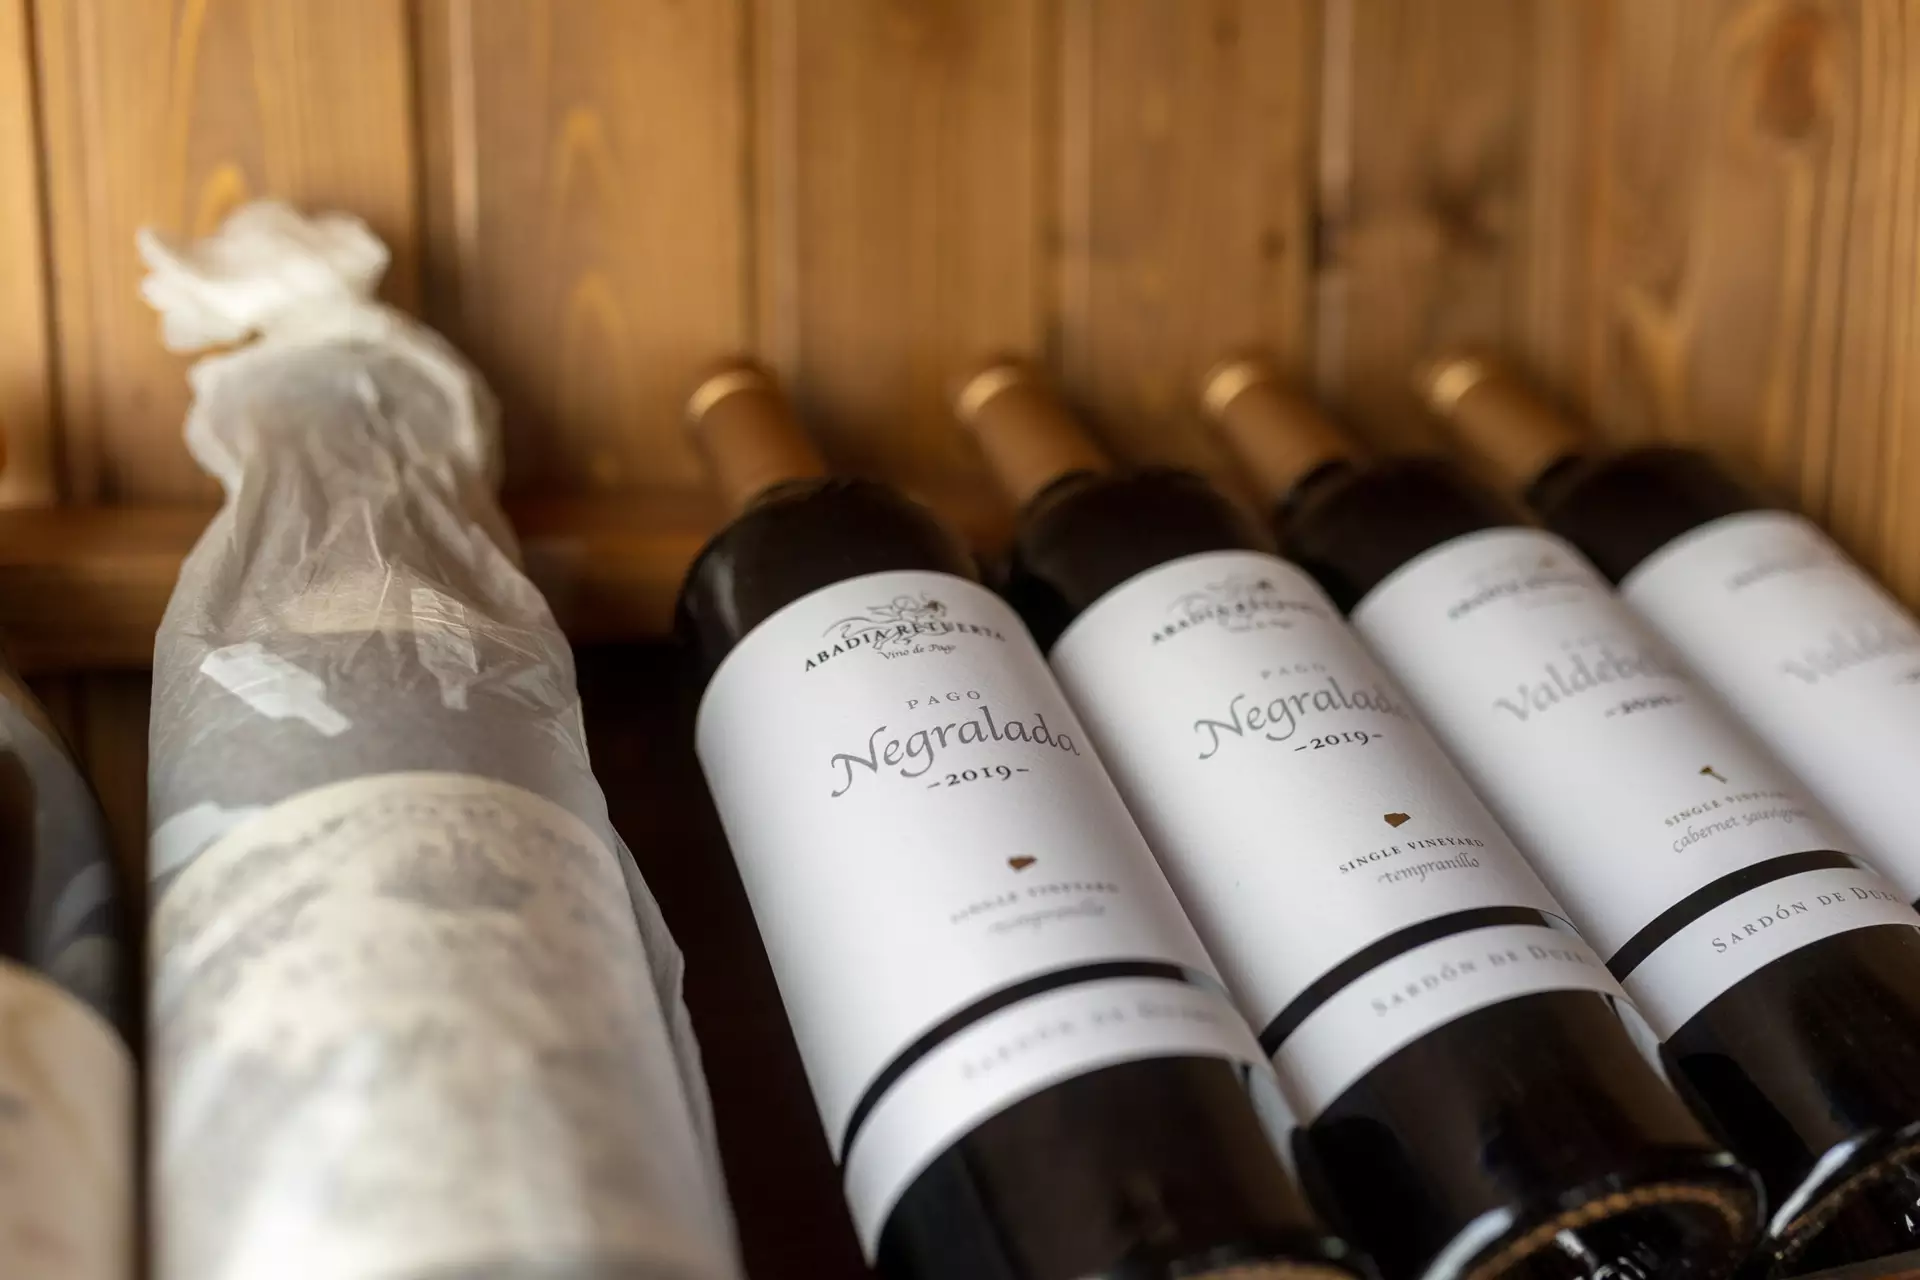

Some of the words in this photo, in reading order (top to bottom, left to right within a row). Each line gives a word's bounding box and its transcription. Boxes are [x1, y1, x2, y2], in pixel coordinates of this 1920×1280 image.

[894, 620, 1008, 643] RETUERTA
[876, 645, 910, 661] Vino
[912, 644, 925, 655] de
[928, 643, 957, 656] Pago
[906, 690, 982, 711] PAGO
[830, 705, 1081, 799] Negralada
[1672, 815, 1741, 855] cabernet
[1742, 806, 1812, 827] sauvig
[1338, 845, 1403, 875] SINGLE
[1406, 836, 1485, 852] VINEYARD
[1376, 851, 1481, 884] tempranillo
[1711, 903, 1809, 954] SARDÓN
[1816, 892, 1847, 907] DE
